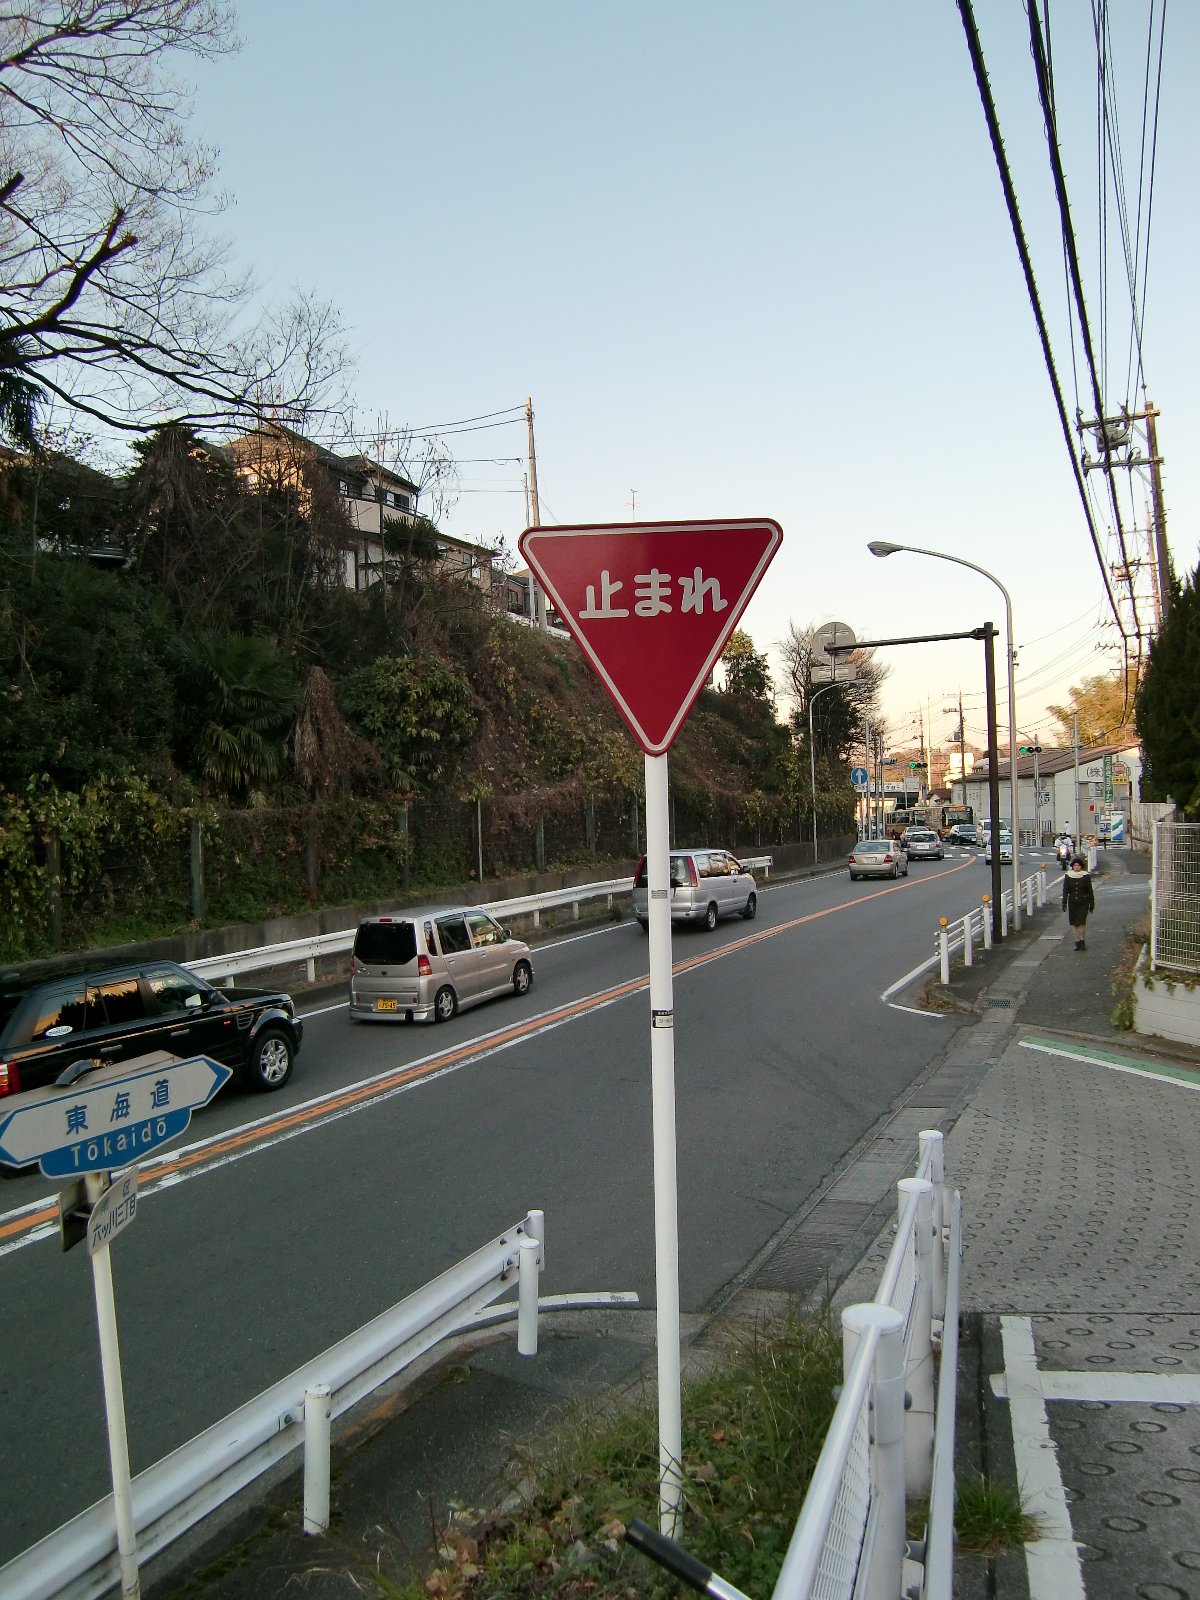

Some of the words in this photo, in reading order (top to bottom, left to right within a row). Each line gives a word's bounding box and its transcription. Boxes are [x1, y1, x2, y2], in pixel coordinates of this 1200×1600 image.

[578, 566, 728, 619] 止まれ
[65, 1078, 170, 1136] 東海道
[71, 1117, 167, 1167] Tōkaidō
